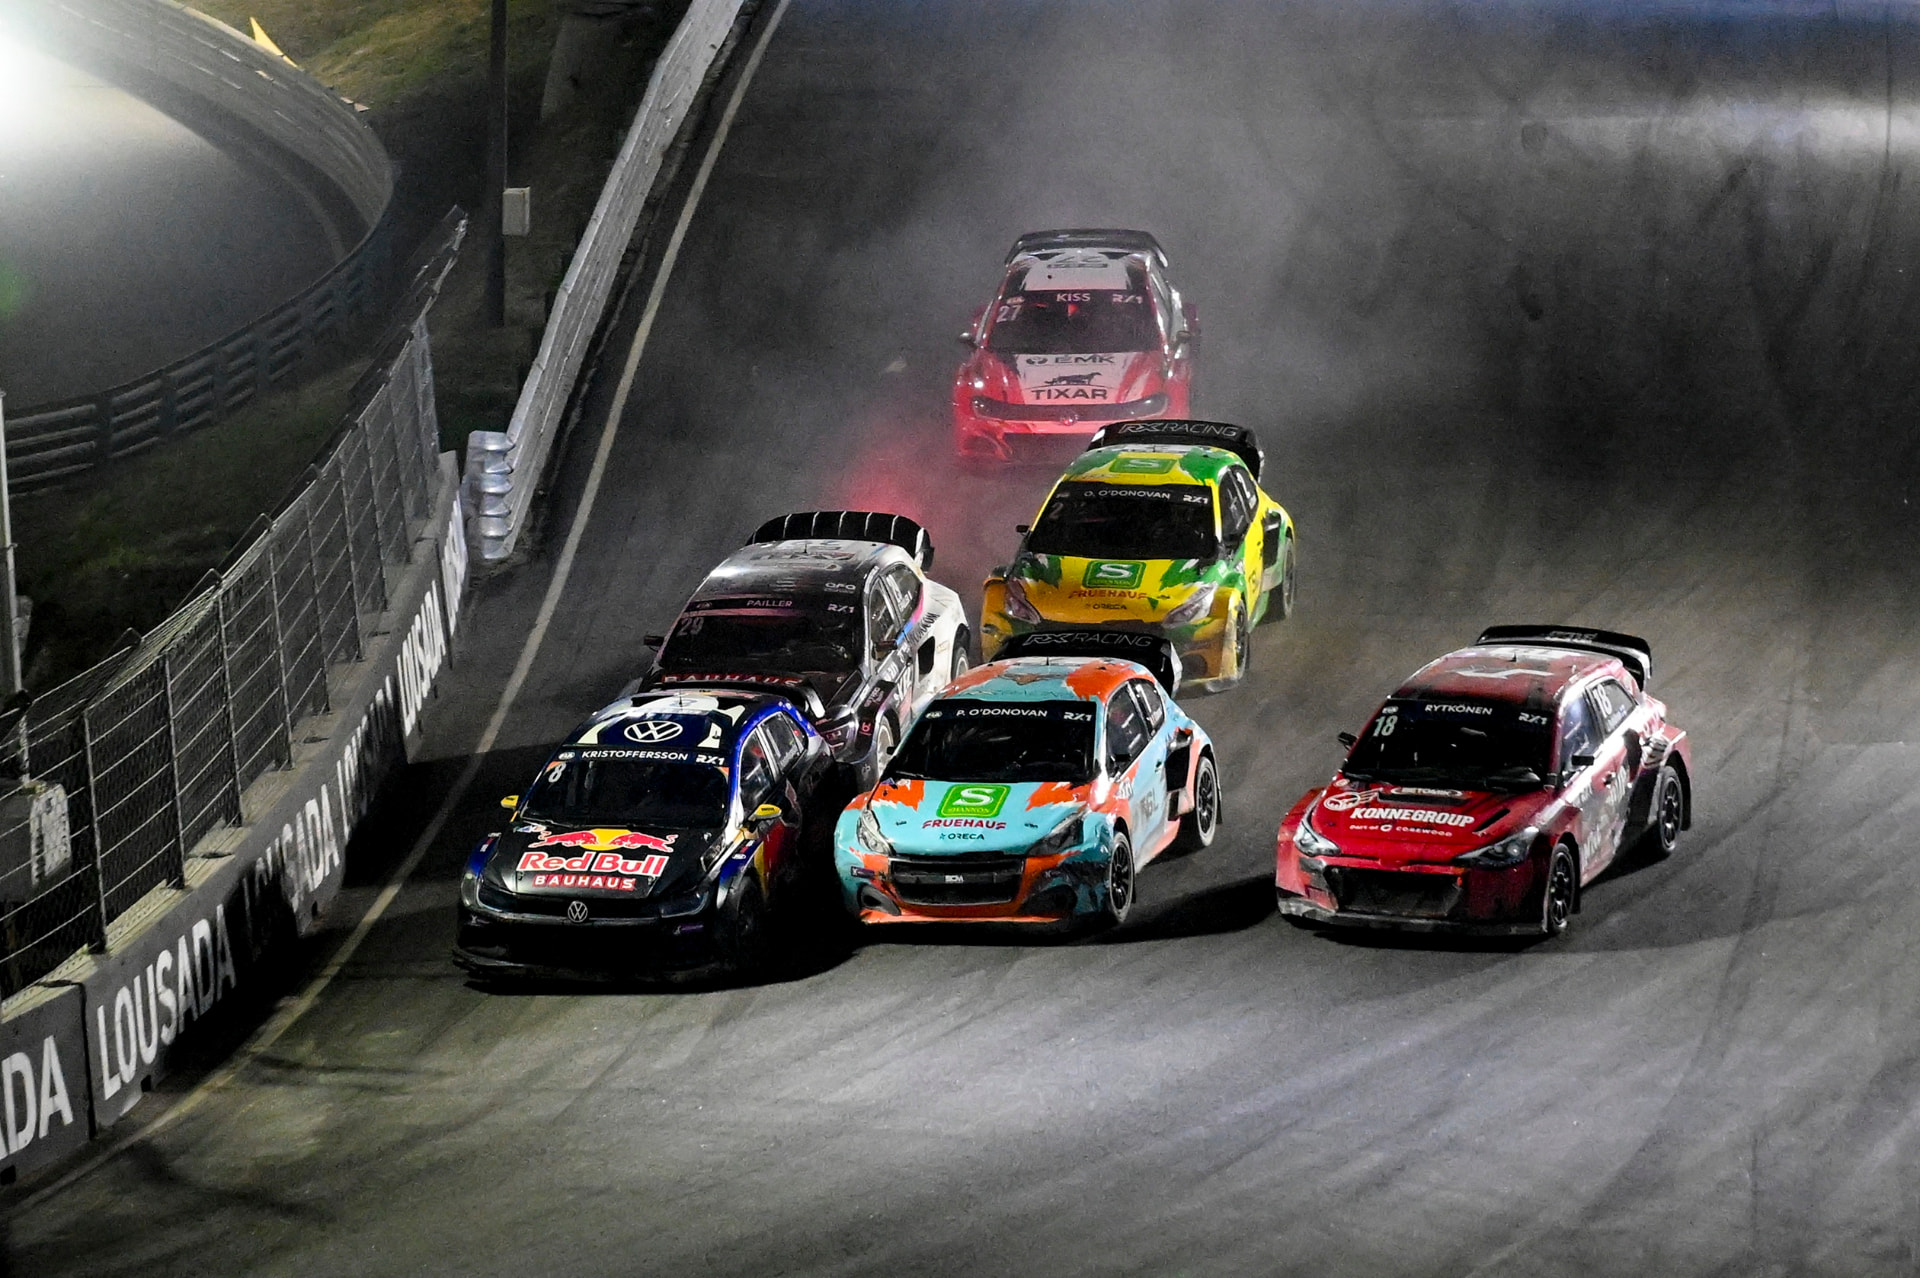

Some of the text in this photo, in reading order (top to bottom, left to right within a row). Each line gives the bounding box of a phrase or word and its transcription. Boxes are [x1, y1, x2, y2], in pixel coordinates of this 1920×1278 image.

[1056, 293, 1091, 302] KISS
[996, 305, 1022, 323] 27
[1031, 388, 1109, 400] TIXAR
[1098, 490, 1171, 499] O'DONOVAN
[1182, 494, 1209, 504] RX1
[746, 600, 793, 608] PAILLER
[827, 603, 856, 613] RX1
[969, 708, 1048, 717] O'DONOVAN
[1424, 703, 1493, 715] RYTKÖNEN
[1063, 711, 1092, 721] RX1
[1518, 712, 1548, 725] RX1
[1373, 715, 1399, 737] 18
[581, 750, 689, 761] KRISTOFFERSSON
[695, 754, 725, 765] RX1
[548, 760, 567, 783] 8
[952, 787, 996, 806] S
[1349, 807, 1475, 827] KONNEGROUP
[516, 851, 670, 877] Red Bull
[534, 874, 636, 890] BAUHAUS
[97, 904, 237, 1101] LOUSADA
